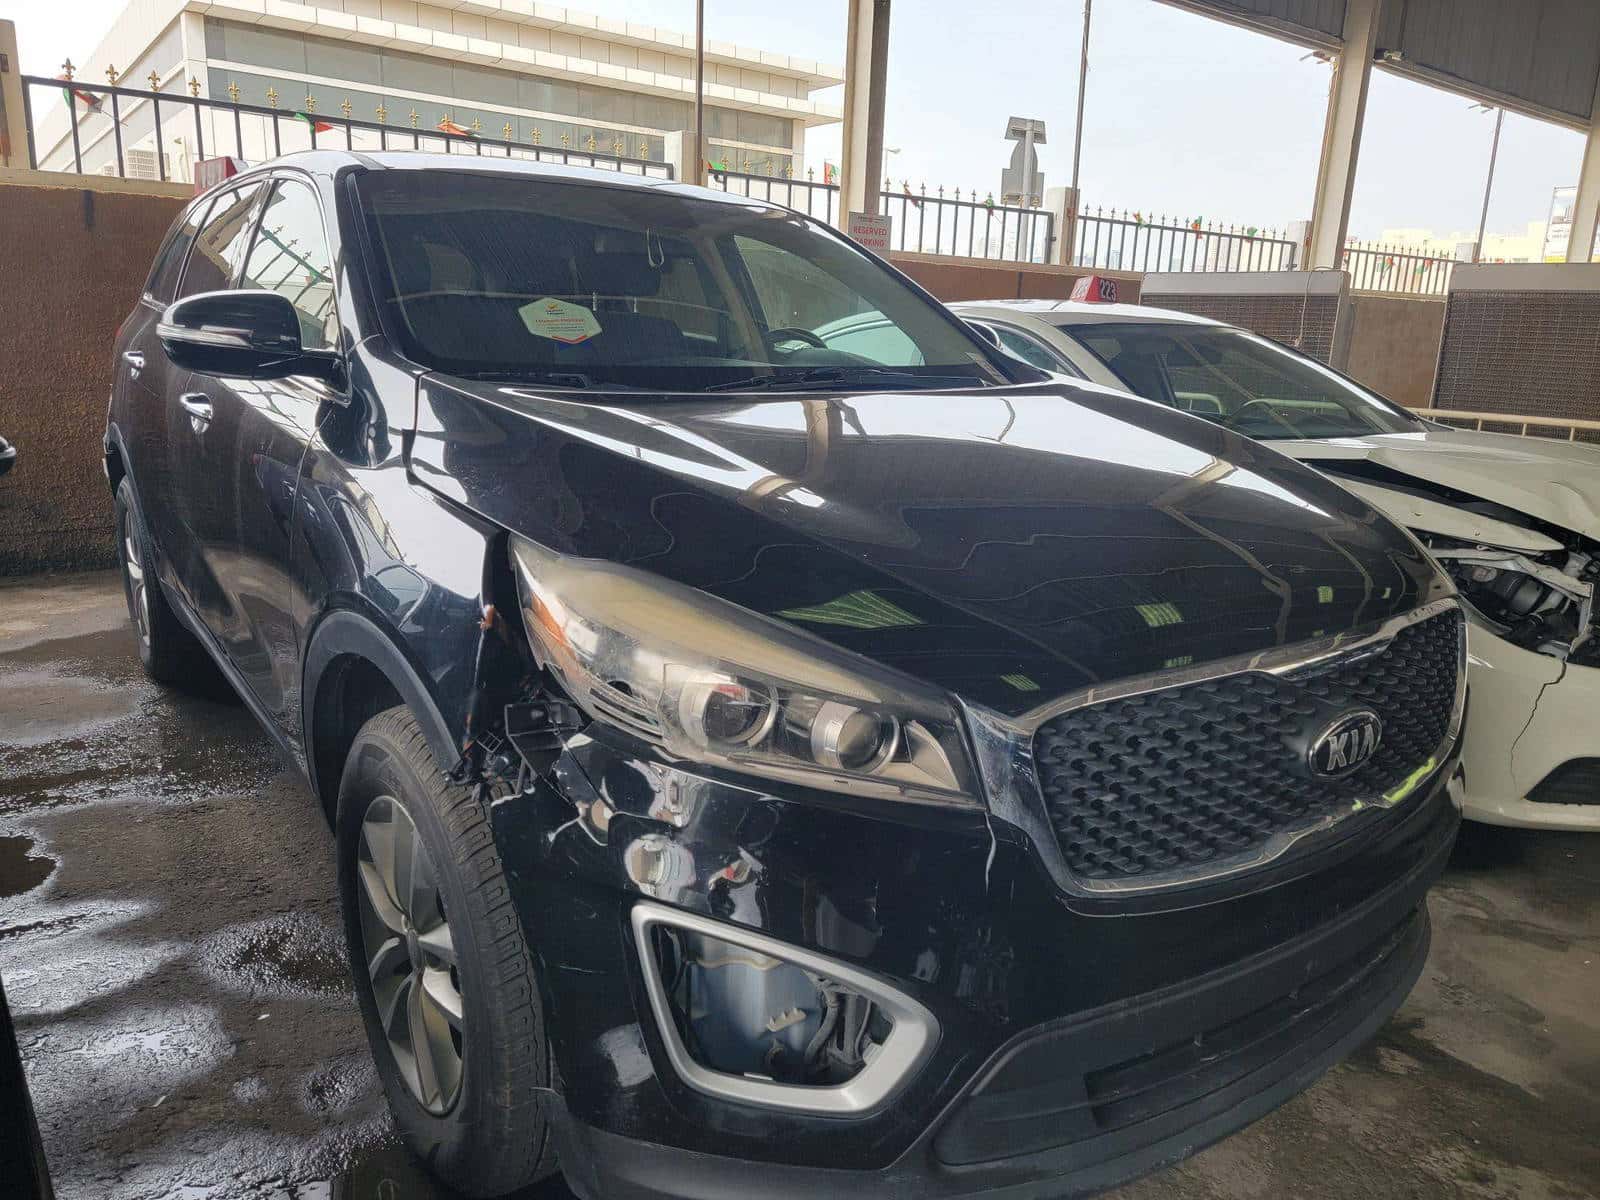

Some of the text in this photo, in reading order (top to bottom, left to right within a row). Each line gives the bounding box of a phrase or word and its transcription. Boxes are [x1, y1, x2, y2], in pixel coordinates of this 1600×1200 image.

[853, 226, 888, 236] RESERVED
[1099, 279, 1117, 302] 223
[1327, 723, 1375, 771] KIA
